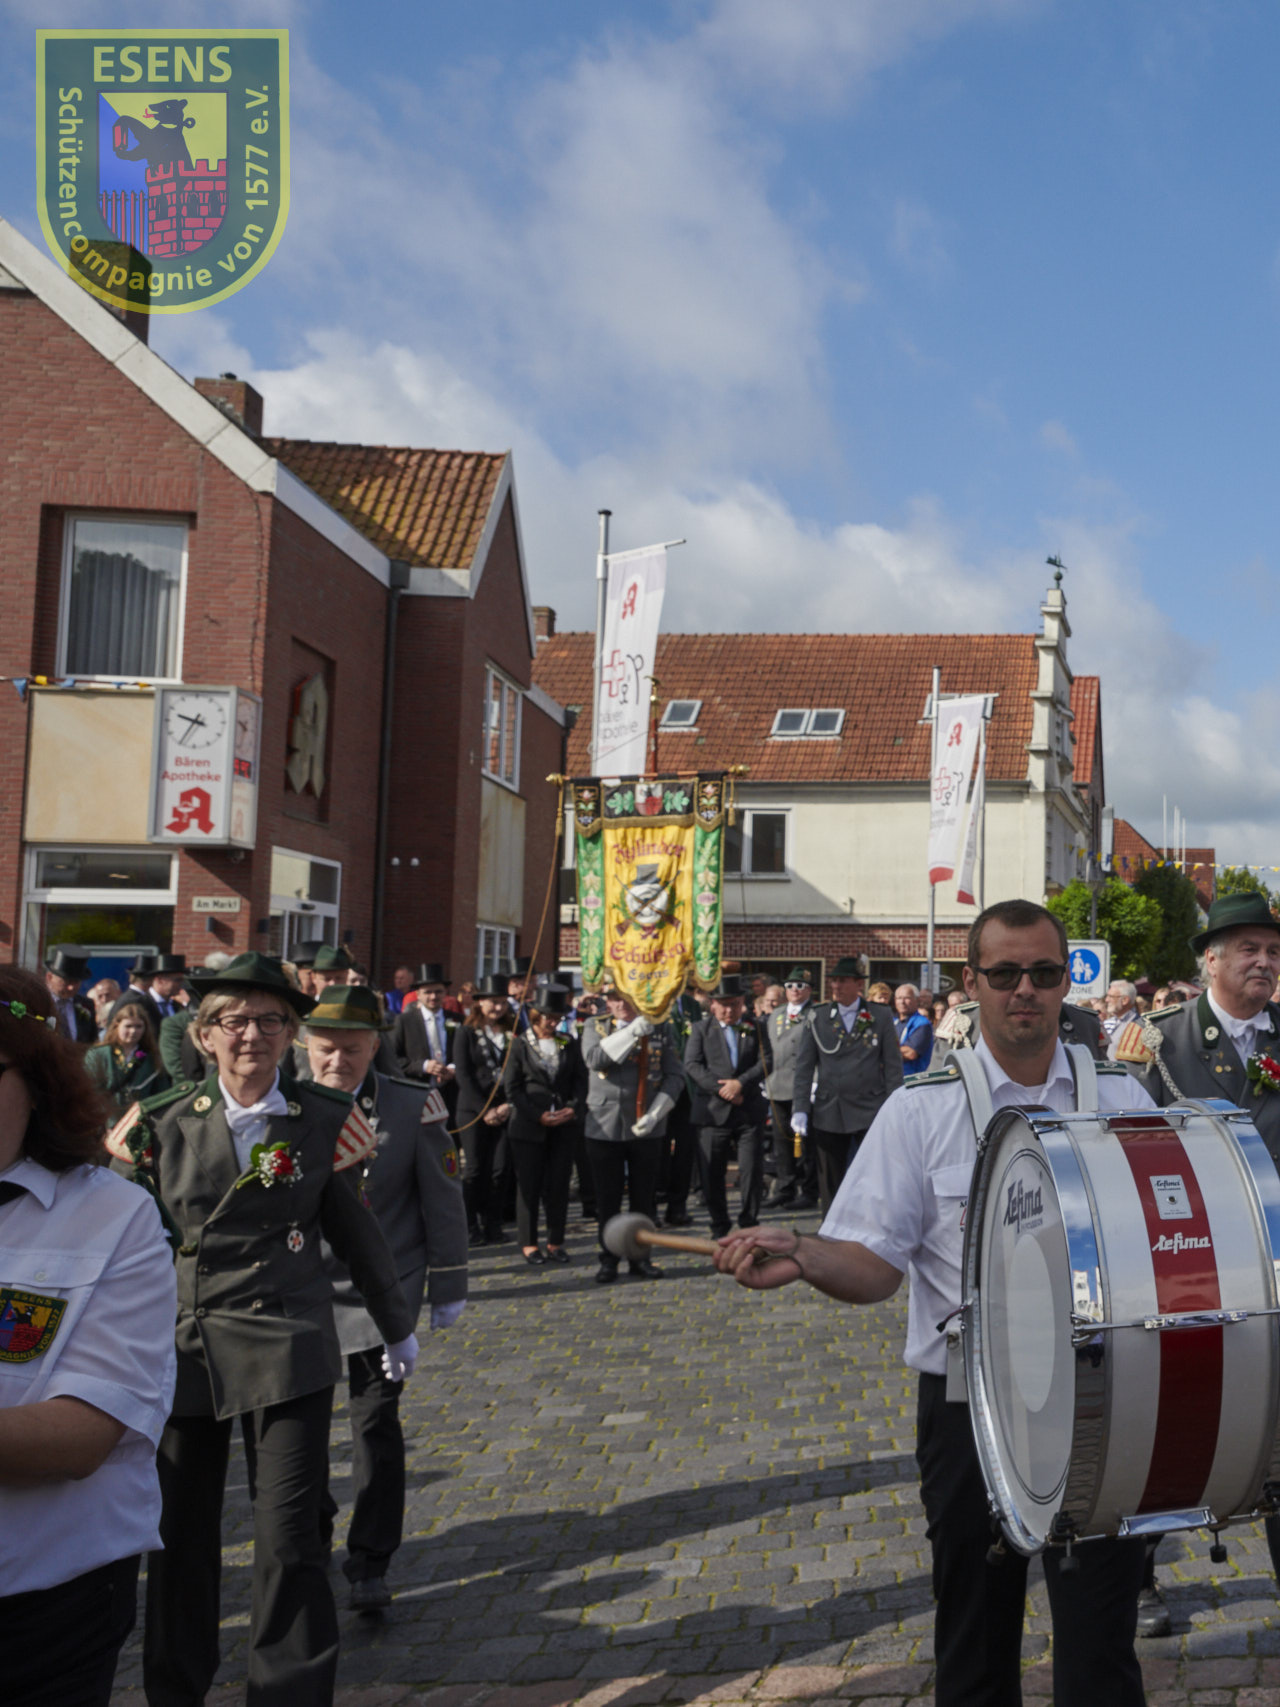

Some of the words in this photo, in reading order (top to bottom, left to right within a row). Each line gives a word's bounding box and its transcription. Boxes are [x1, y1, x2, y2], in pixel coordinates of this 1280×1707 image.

[174, 756, 211, 767] Bären
[160, 770, 222, 783] Apotheke
[196, 899, 210, 909] Am
[212, 899, 238, 909] Markt
[1071, 986, 1093, 995] ZONE
